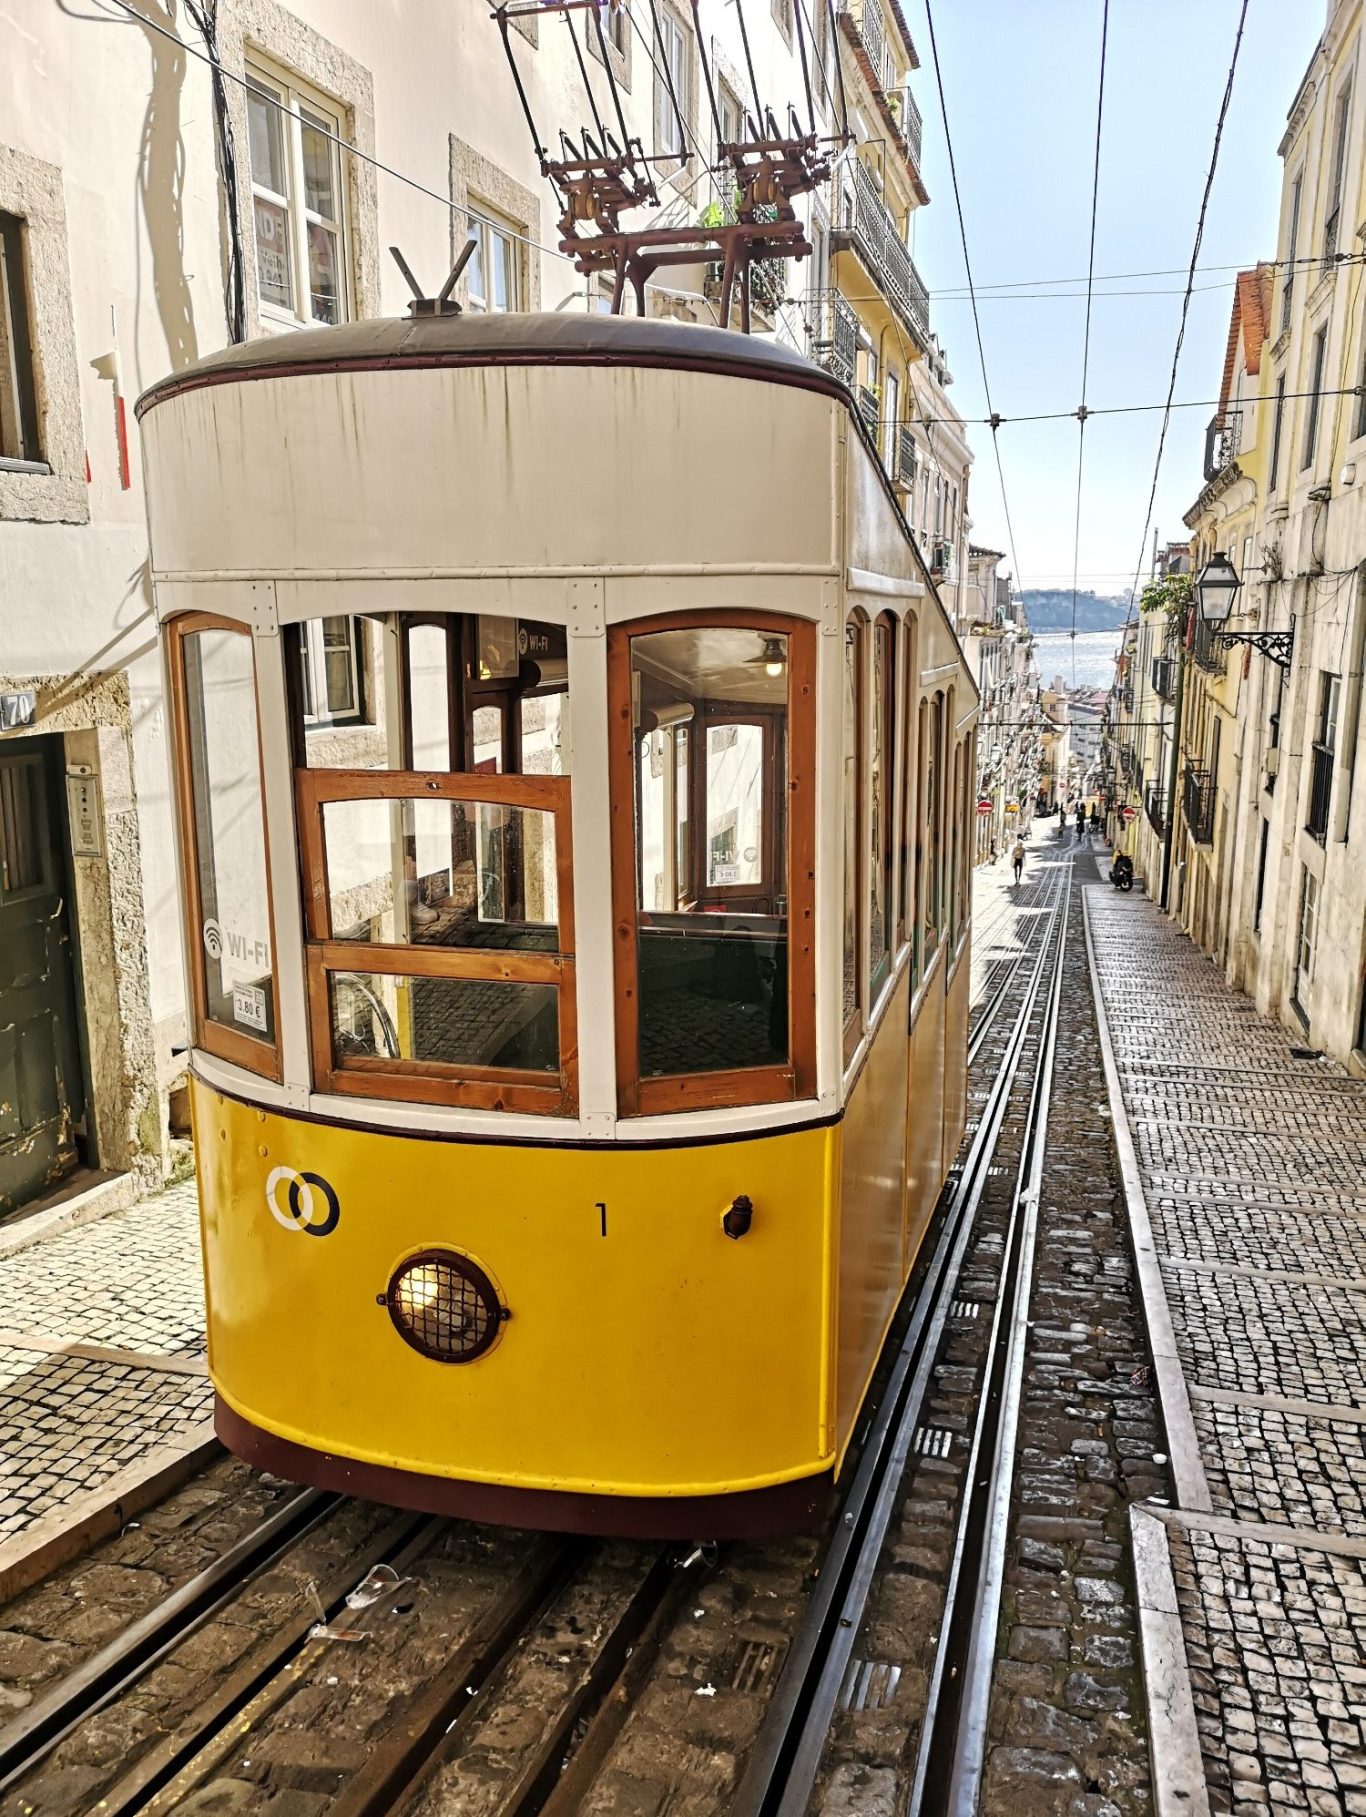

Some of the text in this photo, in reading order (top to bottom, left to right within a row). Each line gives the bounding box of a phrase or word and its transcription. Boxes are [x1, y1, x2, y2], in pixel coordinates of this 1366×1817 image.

[529, 634, 549, 651] WI-FI
[7, 695, 30, 726] 70
[226, 931, 269, 968] WI-FI
[237, 998, 261, 1018] 3.80 €
[594, 1202, 607, 1237] 1
